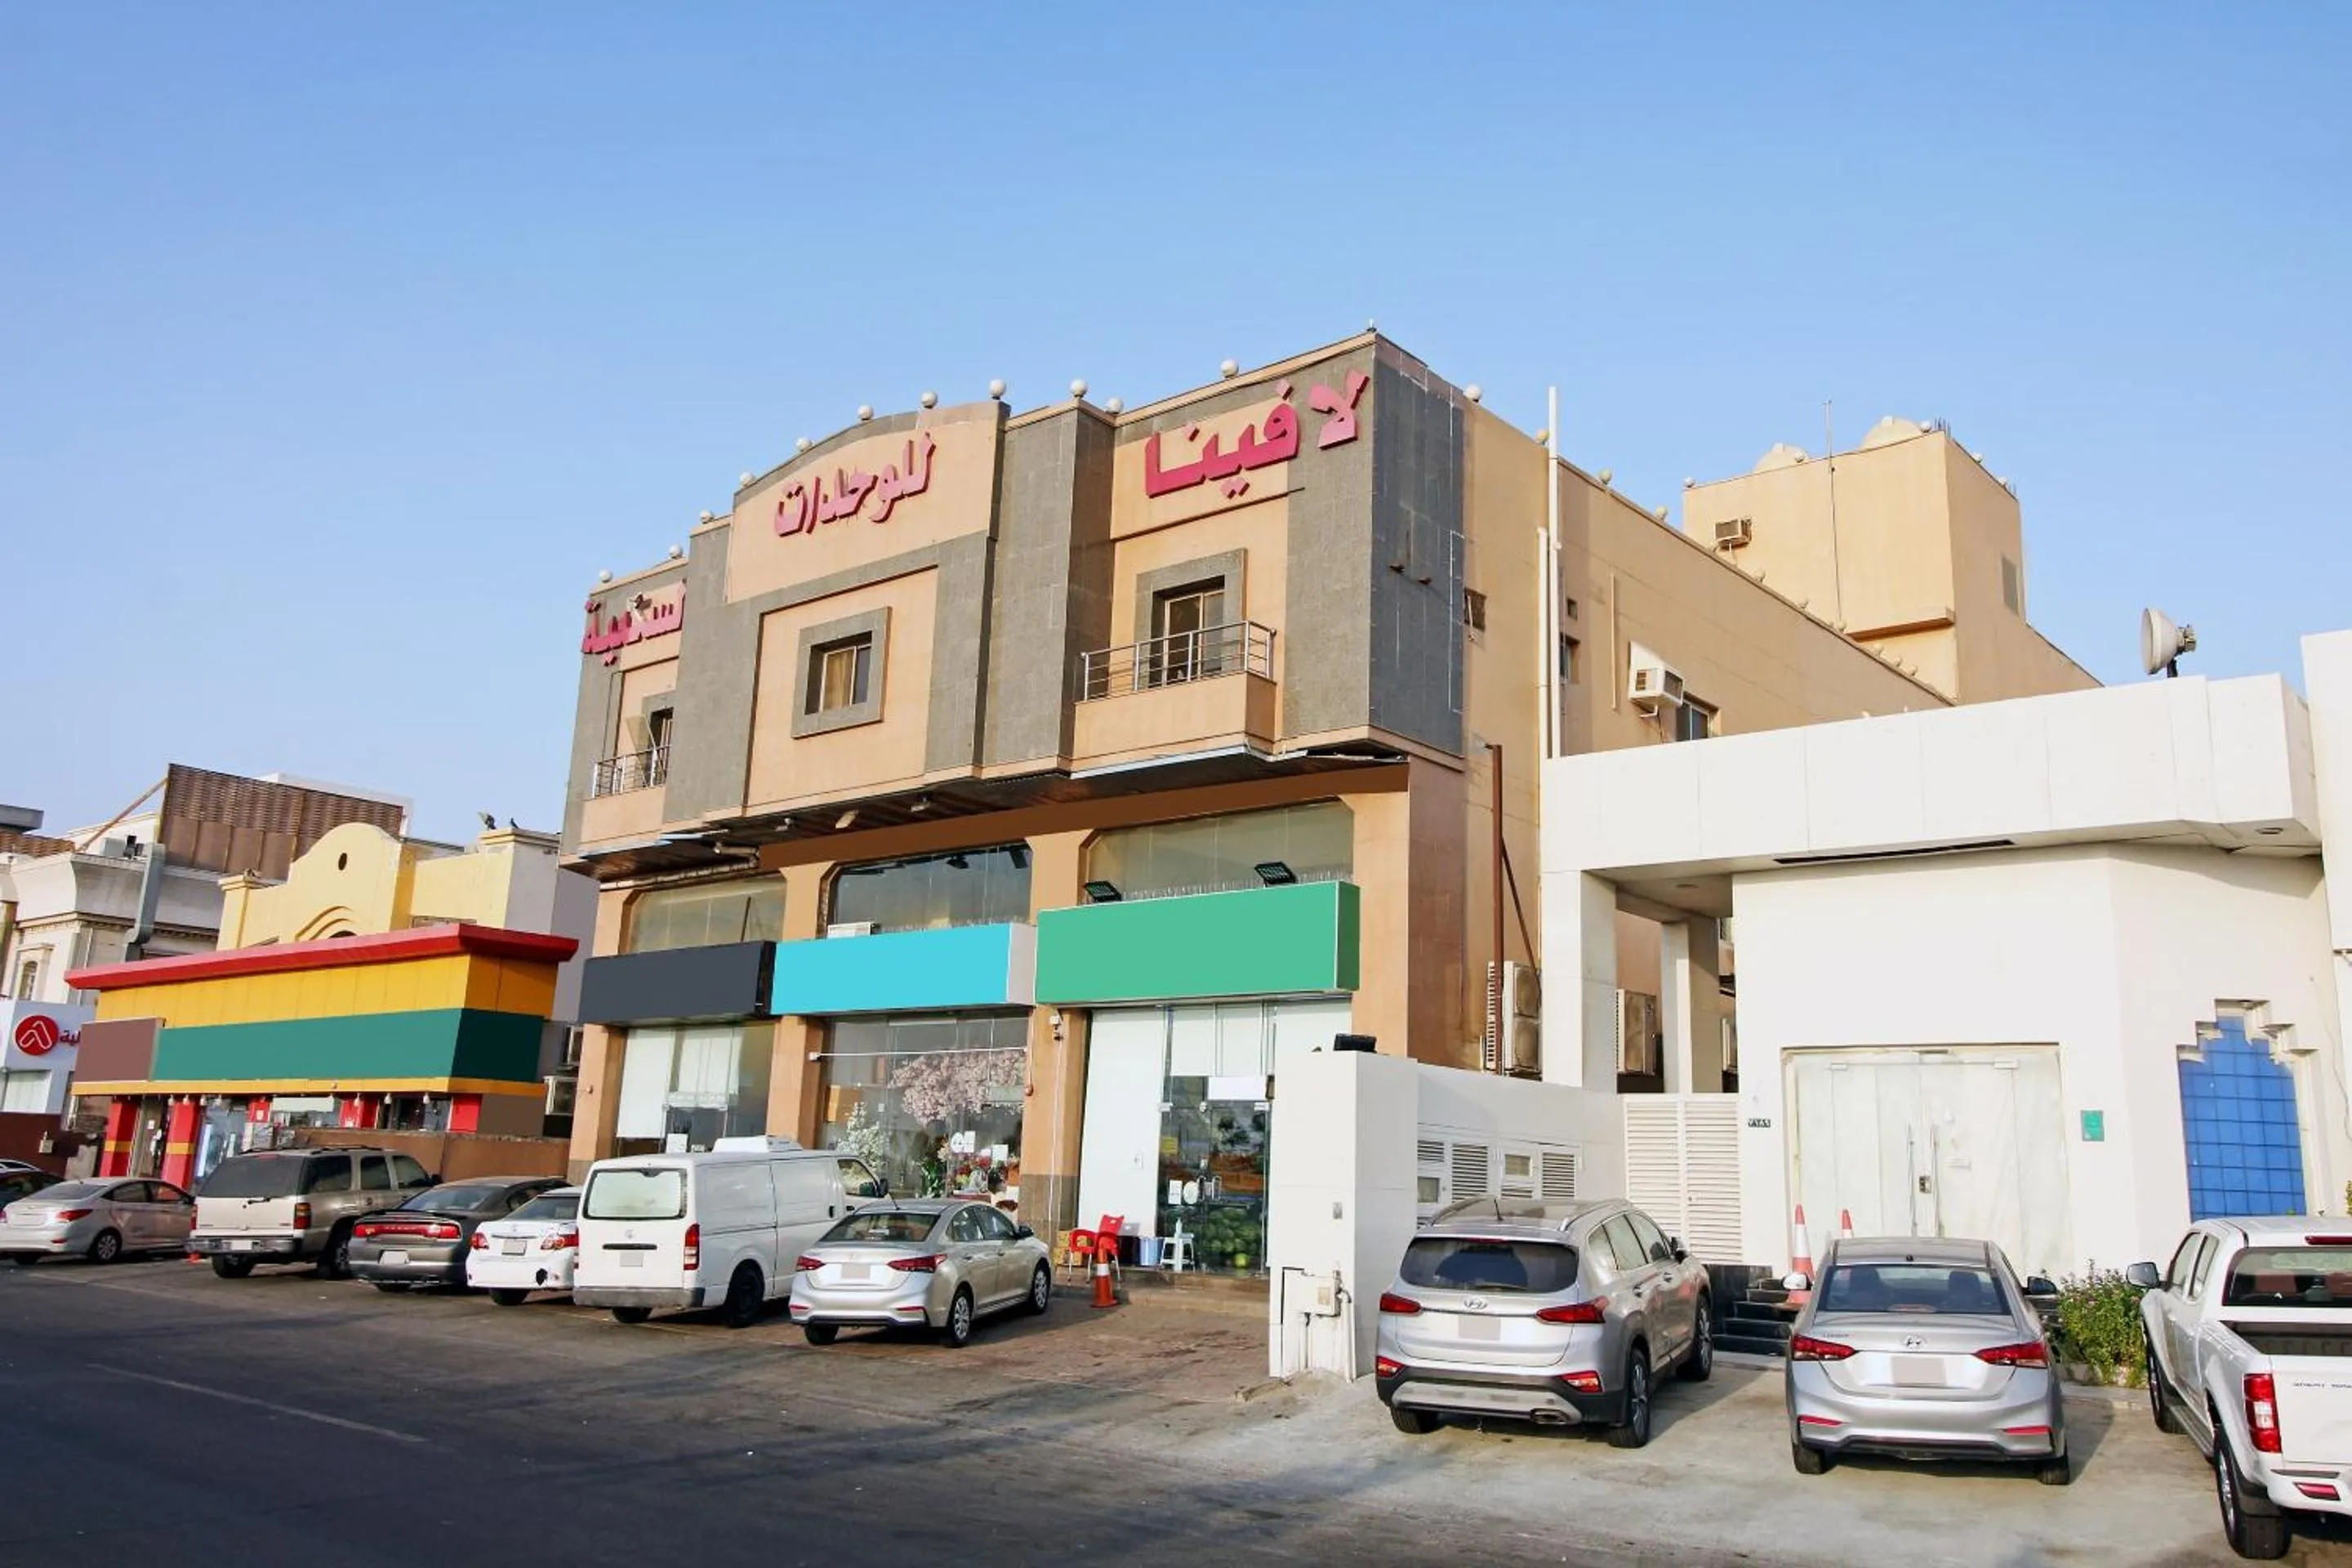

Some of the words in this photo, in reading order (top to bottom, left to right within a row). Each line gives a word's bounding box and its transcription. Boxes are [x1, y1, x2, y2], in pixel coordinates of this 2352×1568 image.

[1144, 378, 1300, 500] فينا
[1309, 369, 1370, 450] لا
[775, 430, 937, 537] للوحدات
